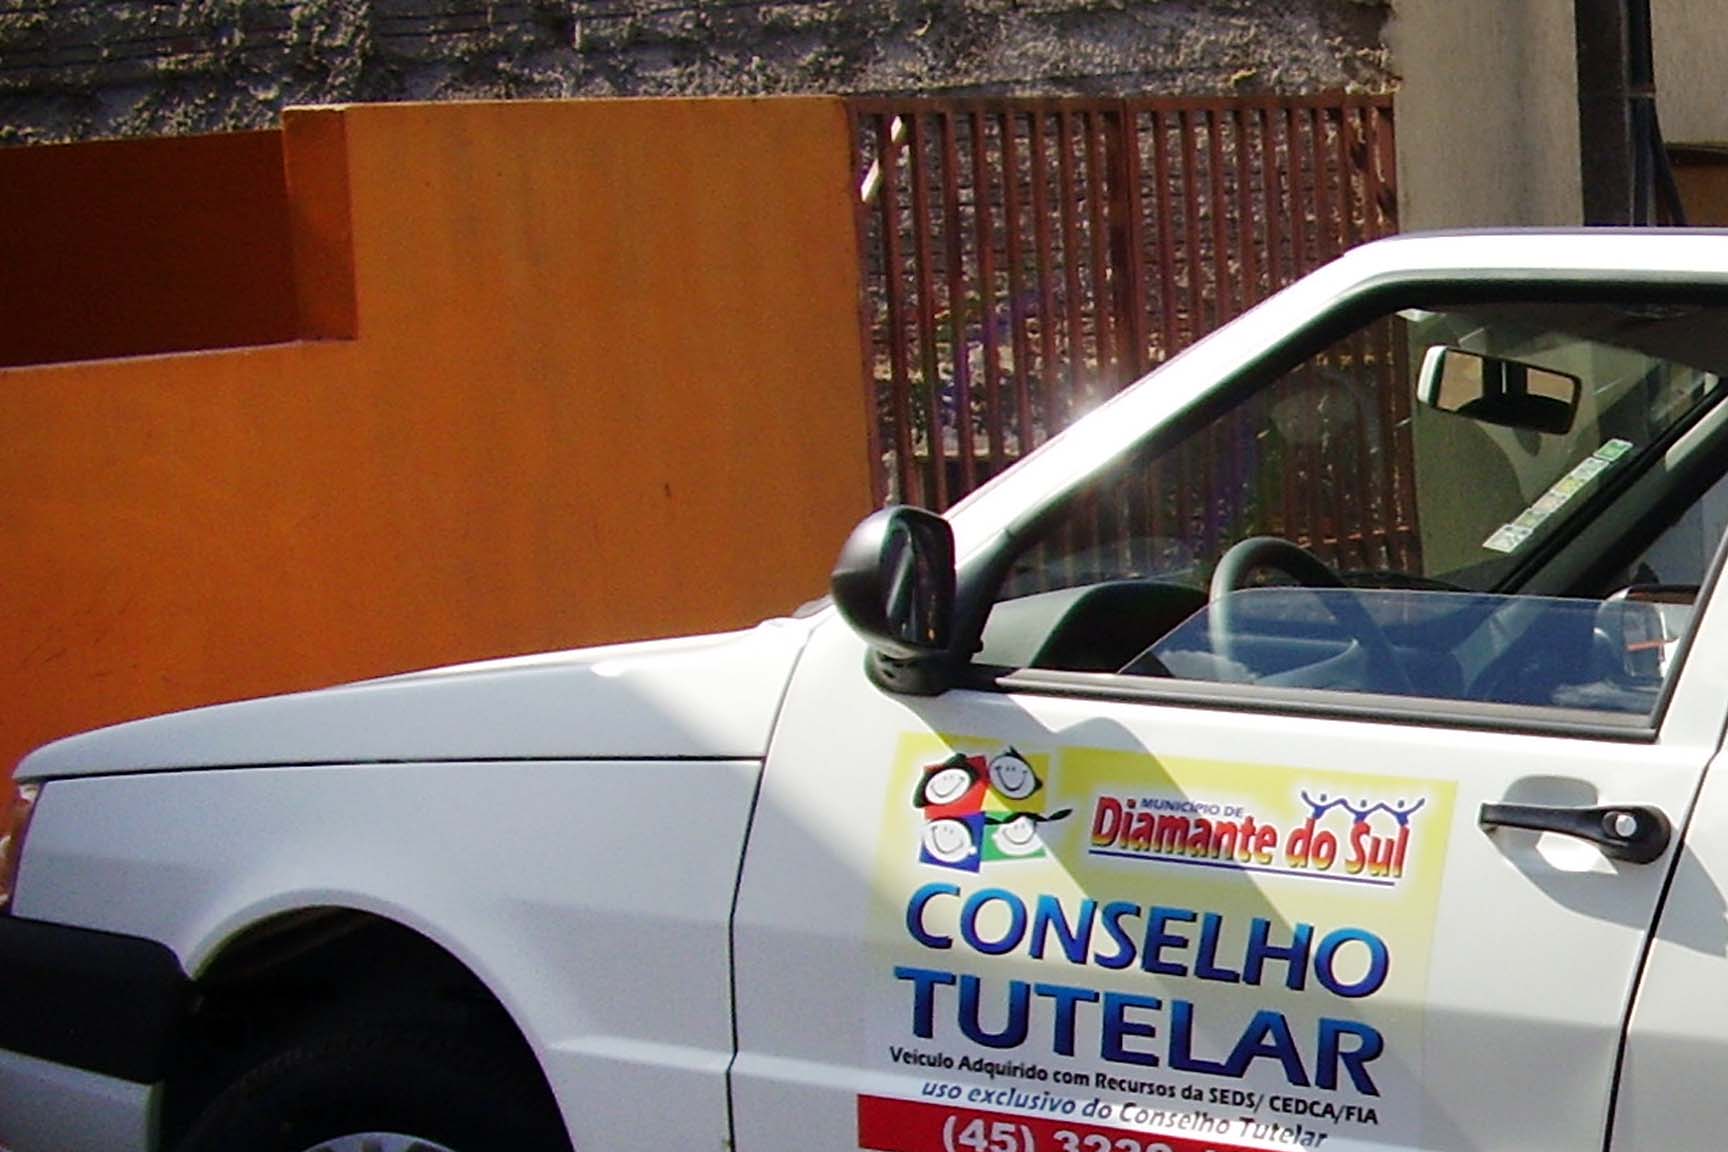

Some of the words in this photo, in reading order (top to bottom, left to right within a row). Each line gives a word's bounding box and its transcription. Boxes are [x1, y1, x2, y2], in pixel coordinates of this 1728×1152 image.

[1091, 796, 1278, 865] Diamante
[1285, 817, 1337, 871] do
[1345, 818, 1411, 879] Sul
[1223, 806, 1244, 818] DE
[904, 882, 1390, 998] CONSELHO
[893, 965, 1385, 1098] TUTELAR
[921, 1081, 962, 1100] uso
[967, 1086, 1076, 1114] exclusivo
[1081, 1098, 1112, 1119] do
[1119, 1102, 1231, 1135] Conselho
[1238, 1116, 1329, 1149] Tutelar
[958, 1055, 1048, 1081] Adquirido
[1053, 1068, 1090, 1087] com
[1095, 1072, 1176, 1098] Recursos
[1181, 1084, 1204, 1102] da
[1208, 1088, 1265, 1114] SEDS/
[1269, 1096, 1379, 1126] CEDCA/FIA
